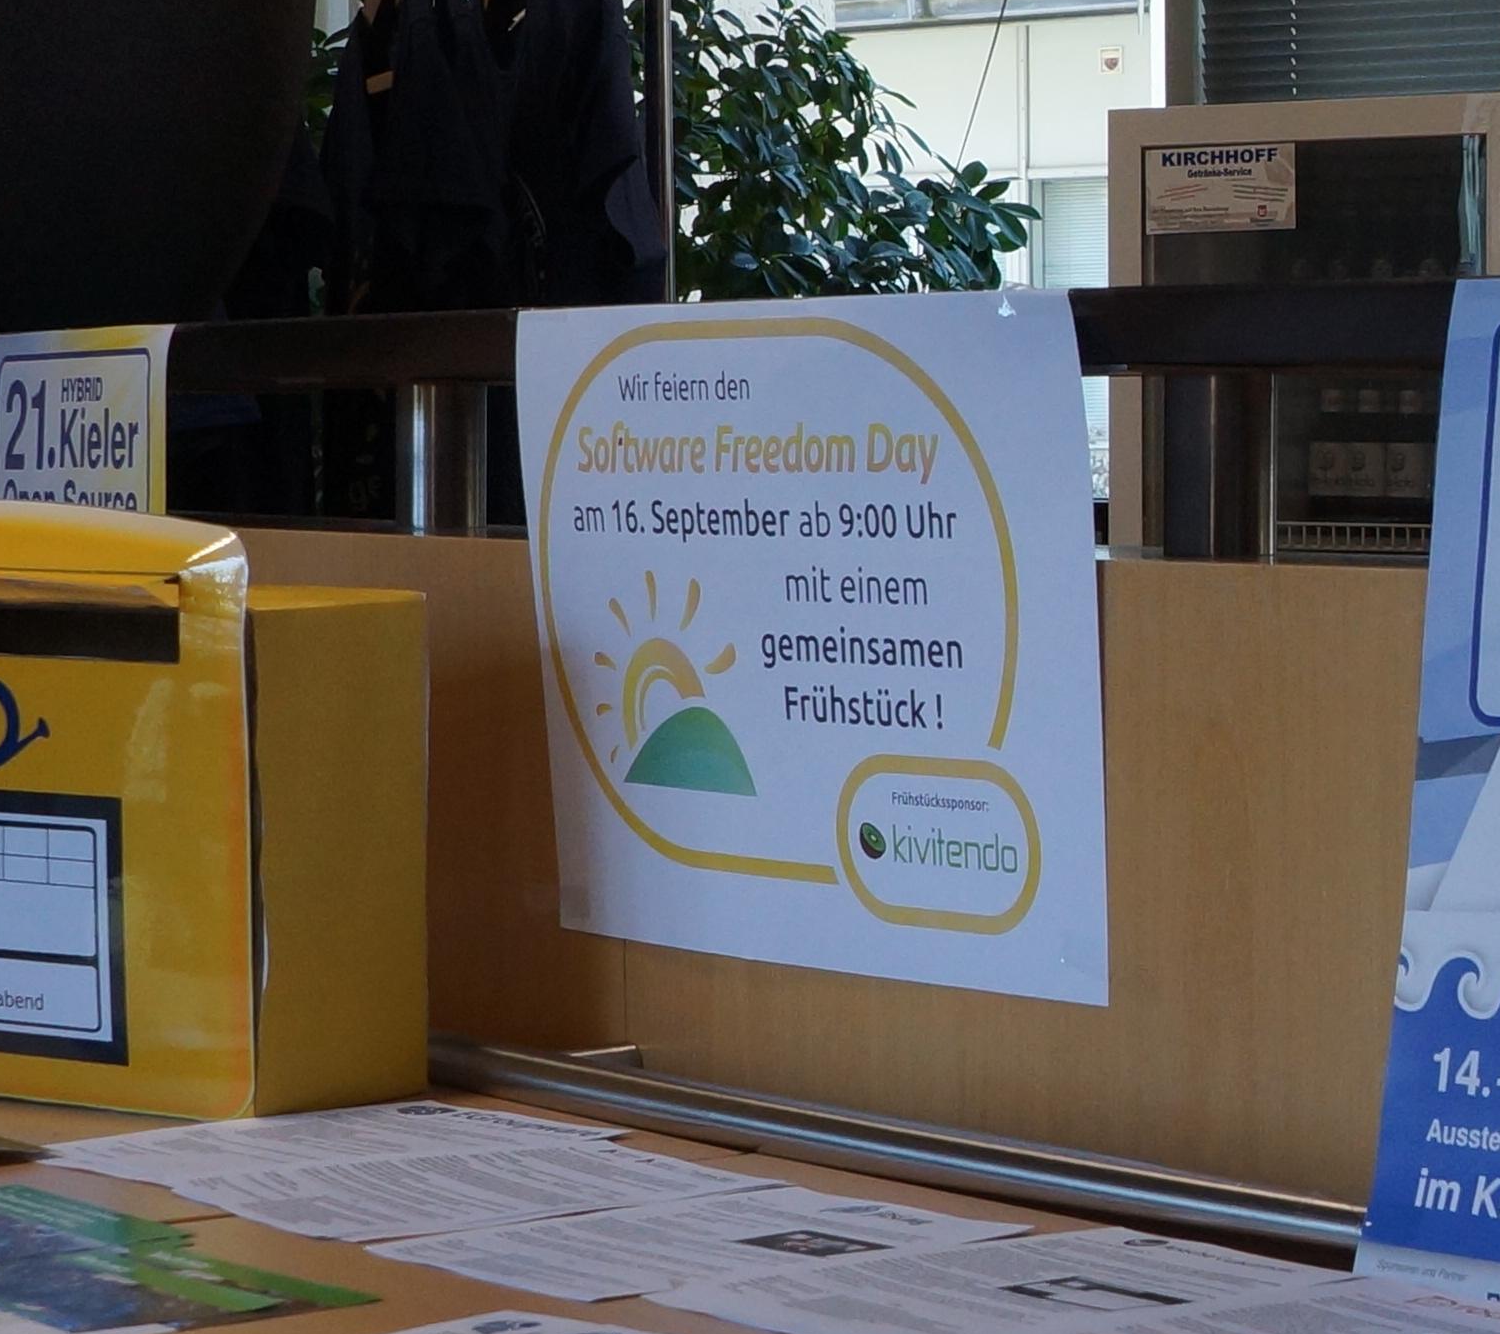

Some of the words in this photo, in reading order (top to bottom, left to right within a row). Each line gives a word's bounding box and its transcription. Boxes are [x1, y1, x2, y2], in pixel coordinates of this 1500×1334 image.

[1162, 148, 1278, 167] KIRCHHOFF
[61, 377, 103, 403] HYBRID
[618, 374, 650, 404] Wir
[655, 373, 709, 404] feiern
[714, 373, 751, 402] den
[4, 380, 56, 470] 21.
[60, 408, 140, 470] Kieler
[577, 422, 705, 475] Software
[714, 422, 856, 474] Freedom
[866, 424, 939, 485] Day
[573, 505, 605, 534] am
[612, 500, 647, 534] 16.
[652, 501, 790, 543] September
[798, 508, 832, 537] ab
[840, 509, 897, 540] 9:00
[907, 509, 957, 541] Uhr
[785, 570, 832, 605] mit
[840, 572, 929, 607] einem
[761, 629, 964, 672] gemeinsamen
[785, 687, 927, 730] Frühstück
[891, 823, 1018, 874] kivitendo
[1414, 1167, 1462, 1214] im
